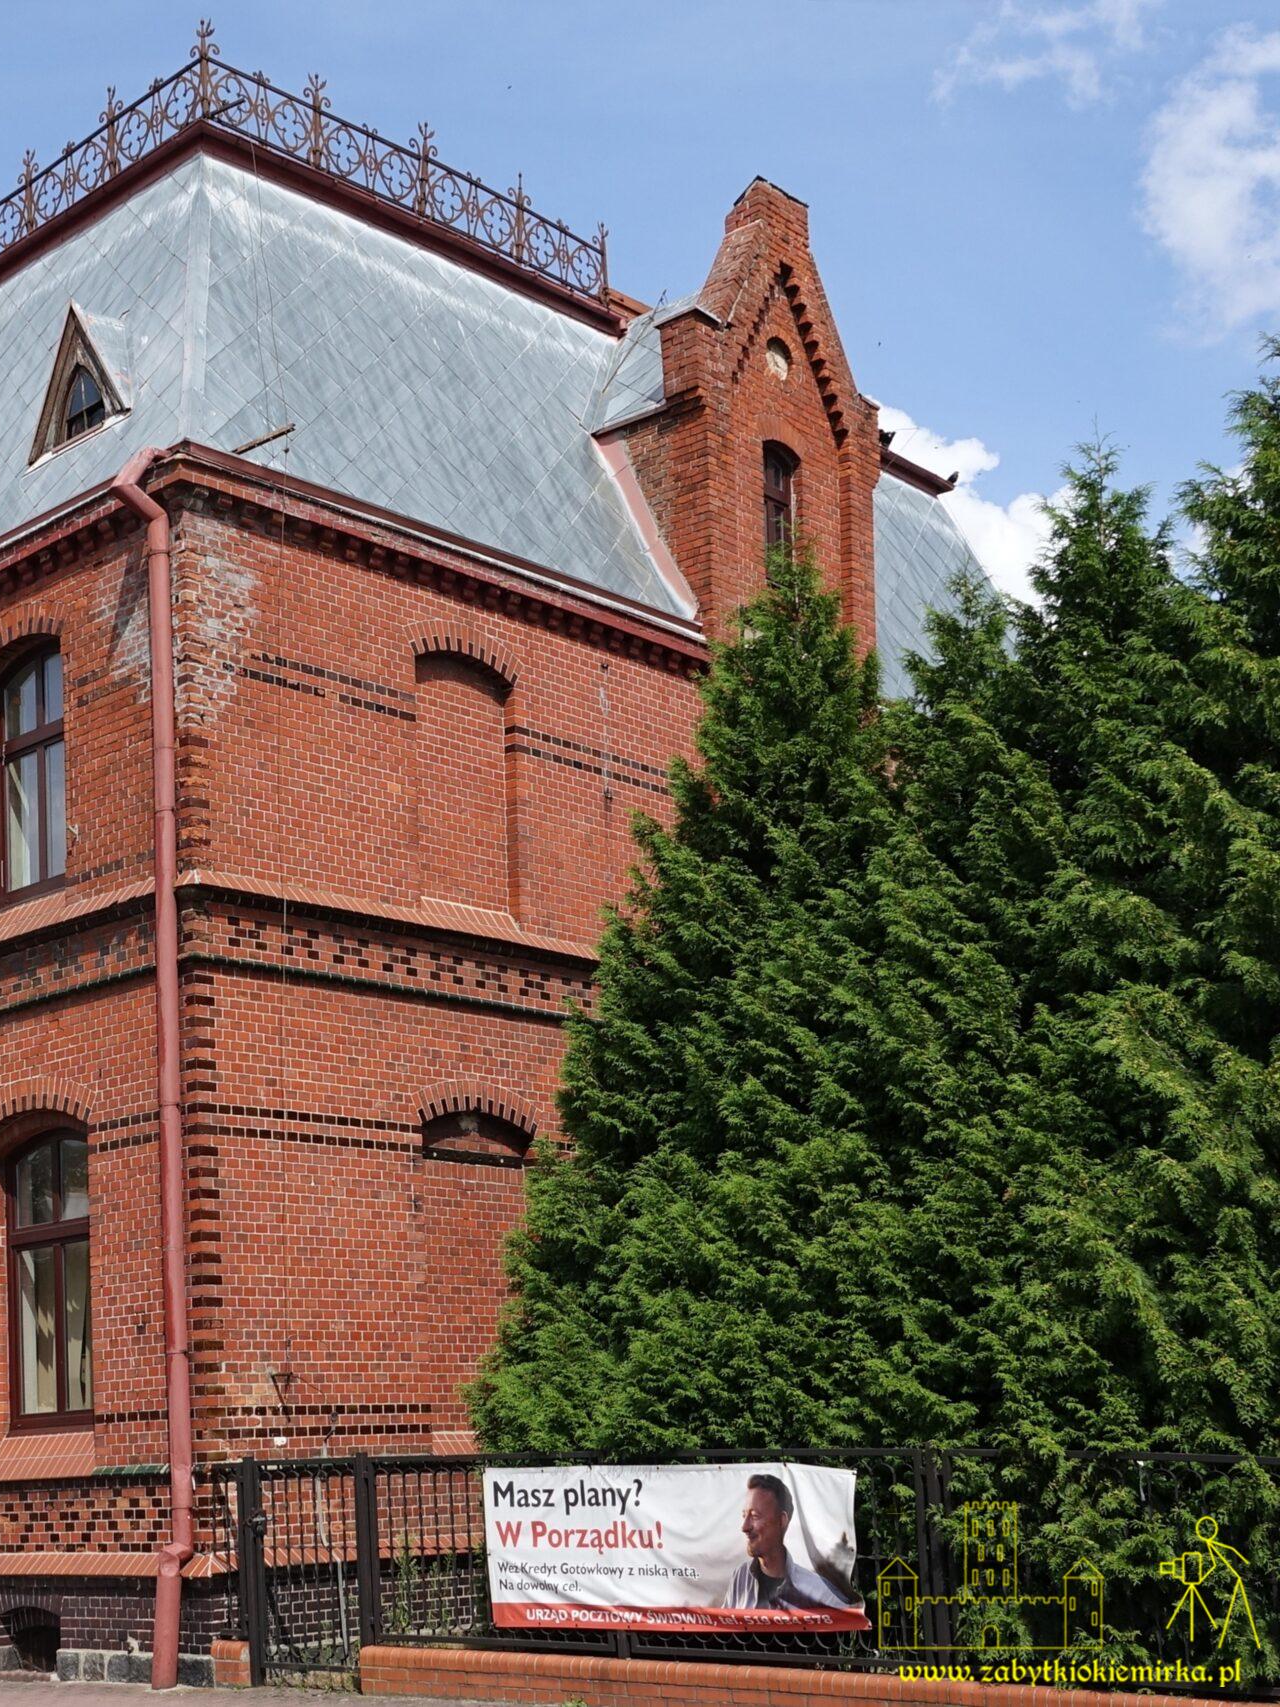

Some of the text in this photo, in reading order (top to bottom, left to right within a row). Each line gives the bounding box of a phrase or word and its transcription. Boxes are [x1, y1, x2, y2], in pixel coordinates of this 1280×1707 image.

[493, 1479, 643, 1515] Masz plany?
[495, 1520, 664, 1555] W Porządku!
[520, 1562, 557, 1577] Kredyt
[560, 1562, 624, 1579] Gotówkowy
[628, 1566, 634, 1575] z
[638, 1564, 669, 1579] niską
[672, 1566, 700, 1579] ratą.
[499, 1579, 582, 1594] Na dowolny cel.
[526, 1609, 568, 1623] URZĄD
[572, 1610, 642, 1623] POCZTOWY
[646, 1610, 717, 1626] ŚWIDWIN,
[718, 1614, 743, 1625] tel.
